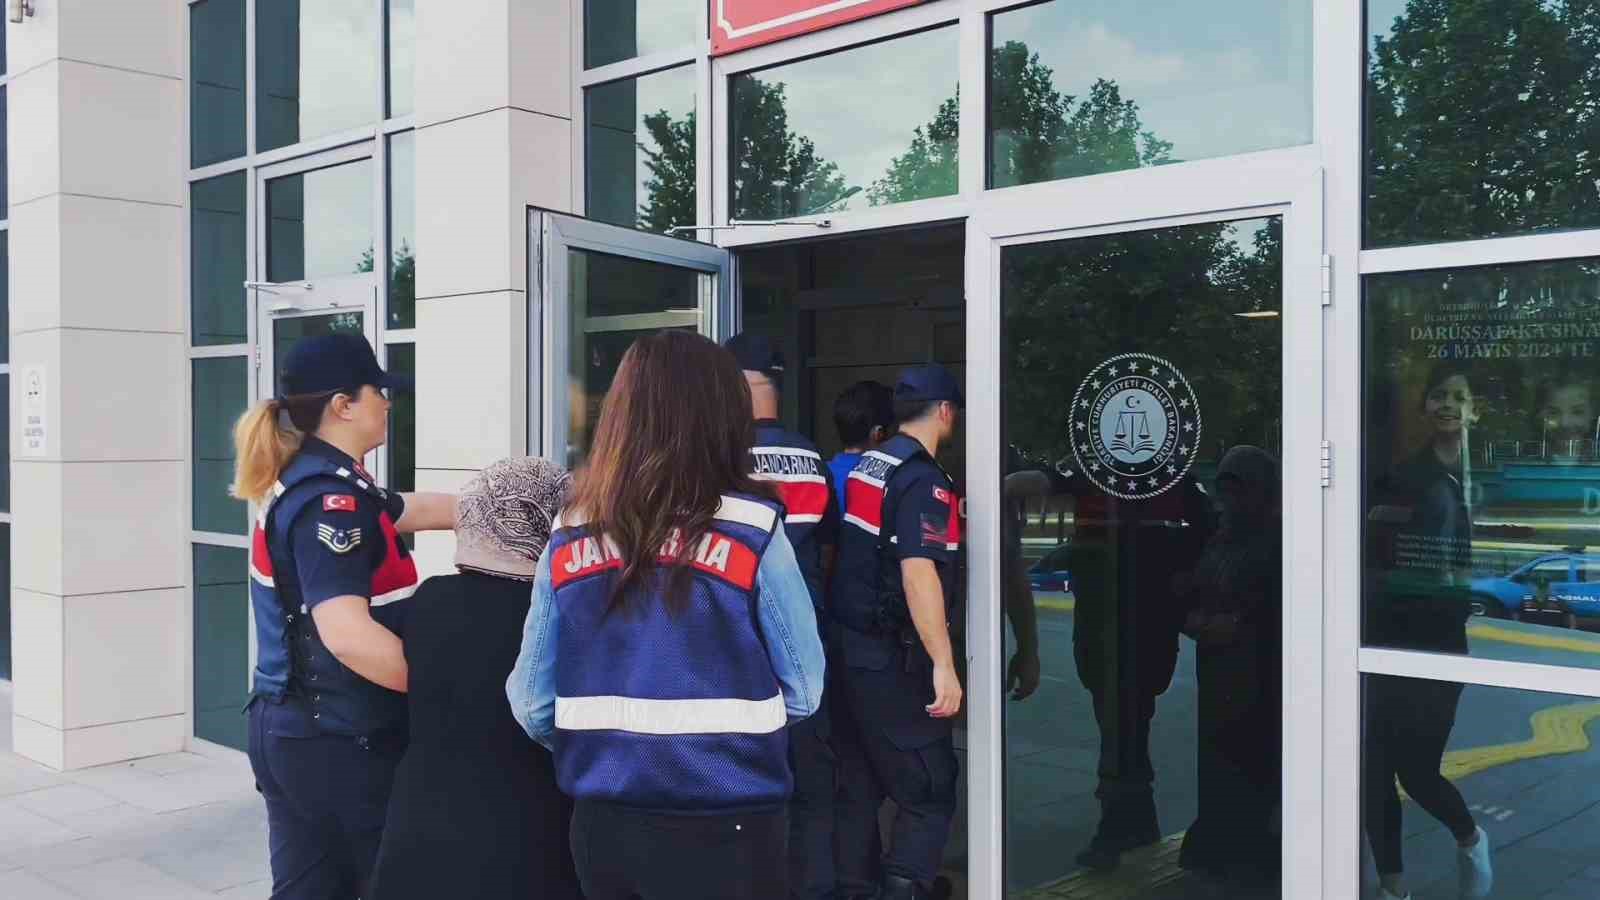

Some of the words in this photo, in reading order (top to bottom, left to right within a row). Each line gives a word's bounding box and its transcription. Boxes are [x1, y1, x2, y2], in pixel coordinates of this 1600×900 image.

[1427, 343, 1449, 359] 26
[1455, 343, 1512, 359] MAYIS
[1141, 381, 1172, 408] ADALET
[753, 454, 818, 475] JANDARMA
